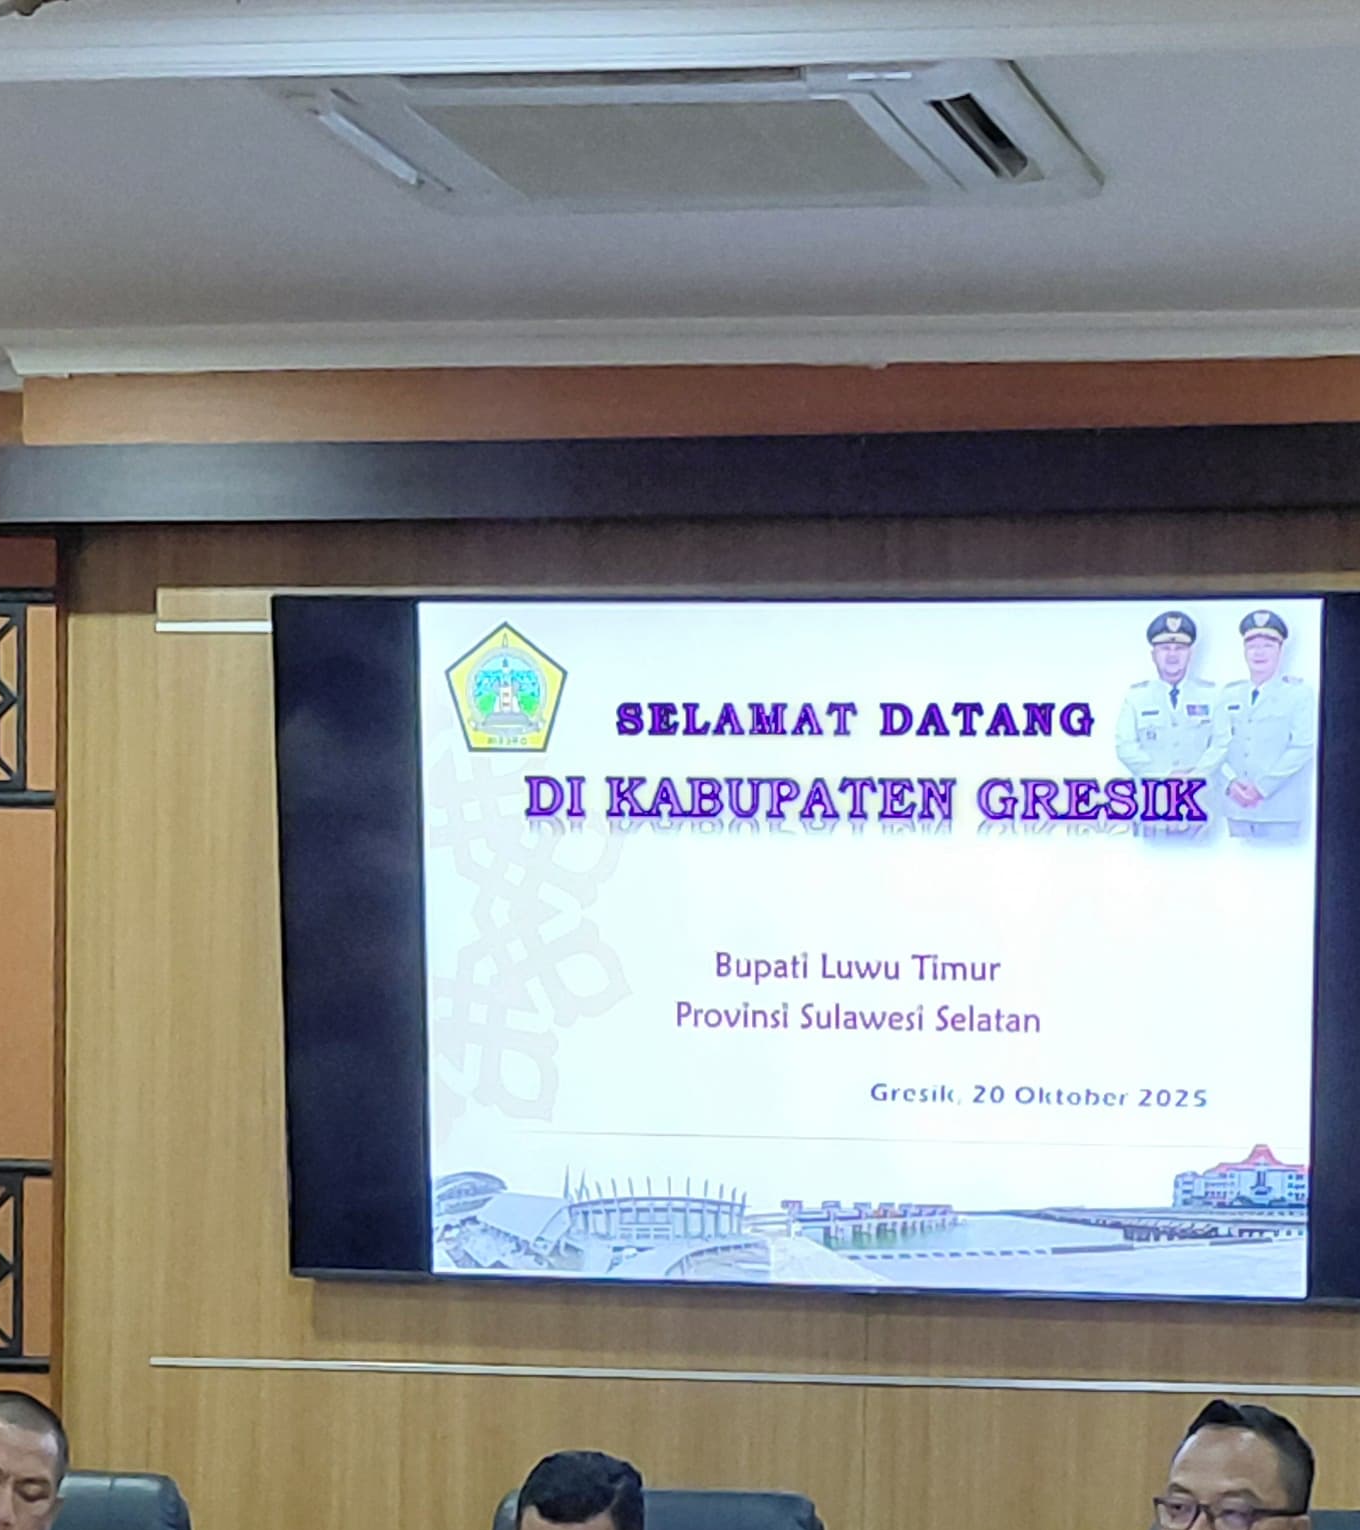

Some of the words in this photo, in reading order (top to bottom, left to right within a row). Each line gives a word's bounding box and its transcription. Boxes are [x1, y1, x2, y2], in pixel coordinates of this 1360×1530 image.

[616, 702, 857, 736] SELAMAT
[880, 702, 1095, 737] DATANG
[525, 776, 586, 817] DI
[605, 776, 956, 819] KABUPATEN
[977, 778, 1208, 820] GRESIK
[715, 951, 808, 985] Bupati
[821, 953, 900, 980] Luwu
[911, 954, 1001, 982] Timur
[676, 1001, 789, 1029] Provinsi
[800, 1003, 924, 1032] Sulawesi
[935, 1005, 1040, 1033] Selatan
[972, 1085, 1005, 1104] 20
[1015, 1086, 1128, 1107] Oktober
[1138, 1088, 1208, 1108] 2025
